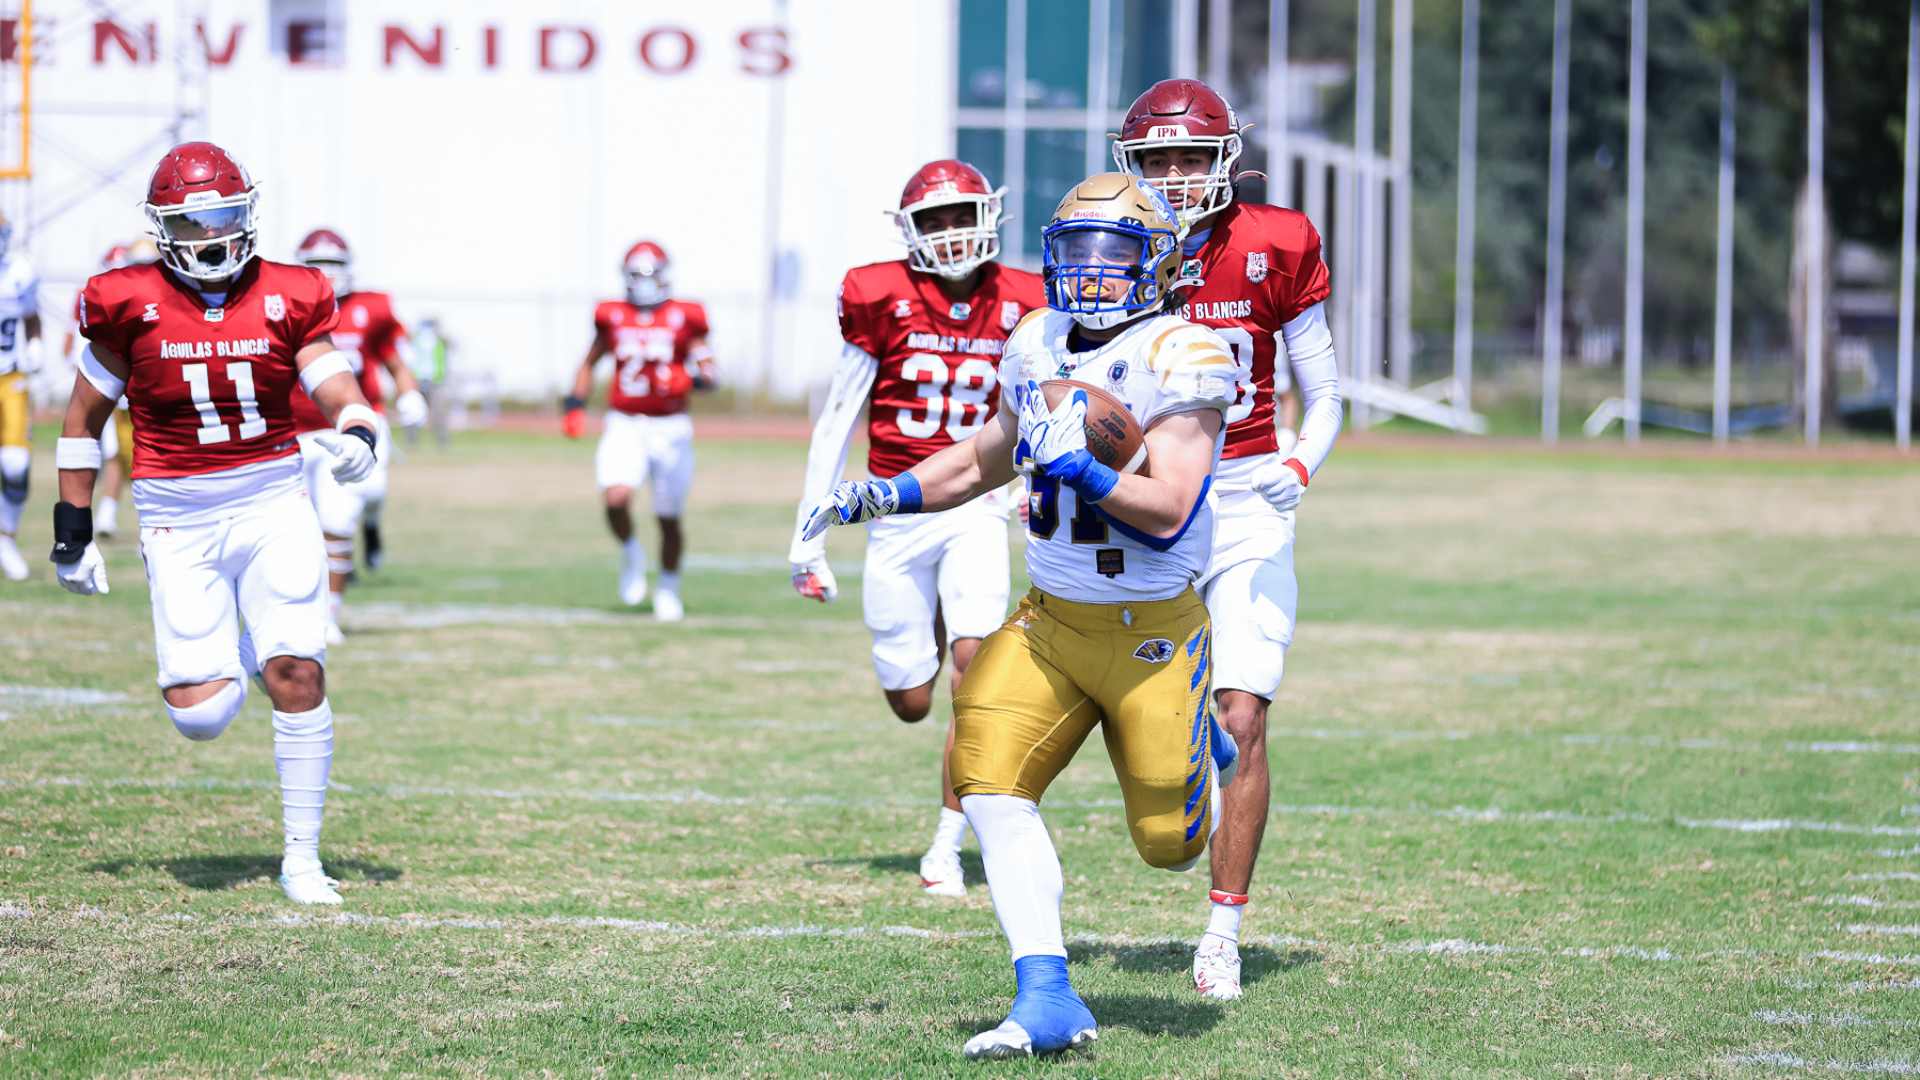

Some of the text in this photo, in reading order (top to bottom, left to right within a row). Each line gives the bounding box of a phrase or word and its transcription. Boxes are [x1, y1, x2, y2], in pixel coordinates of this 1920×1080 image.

[1156, 127, 1178, 138] IPN
[1195, 300, 1252, 320] BLANCAS
[160, 337, 270, 359] ÁGUILAS BLANCAS
[182, 361, 267, 445] 11
[896, 352, 997, 443] 38
